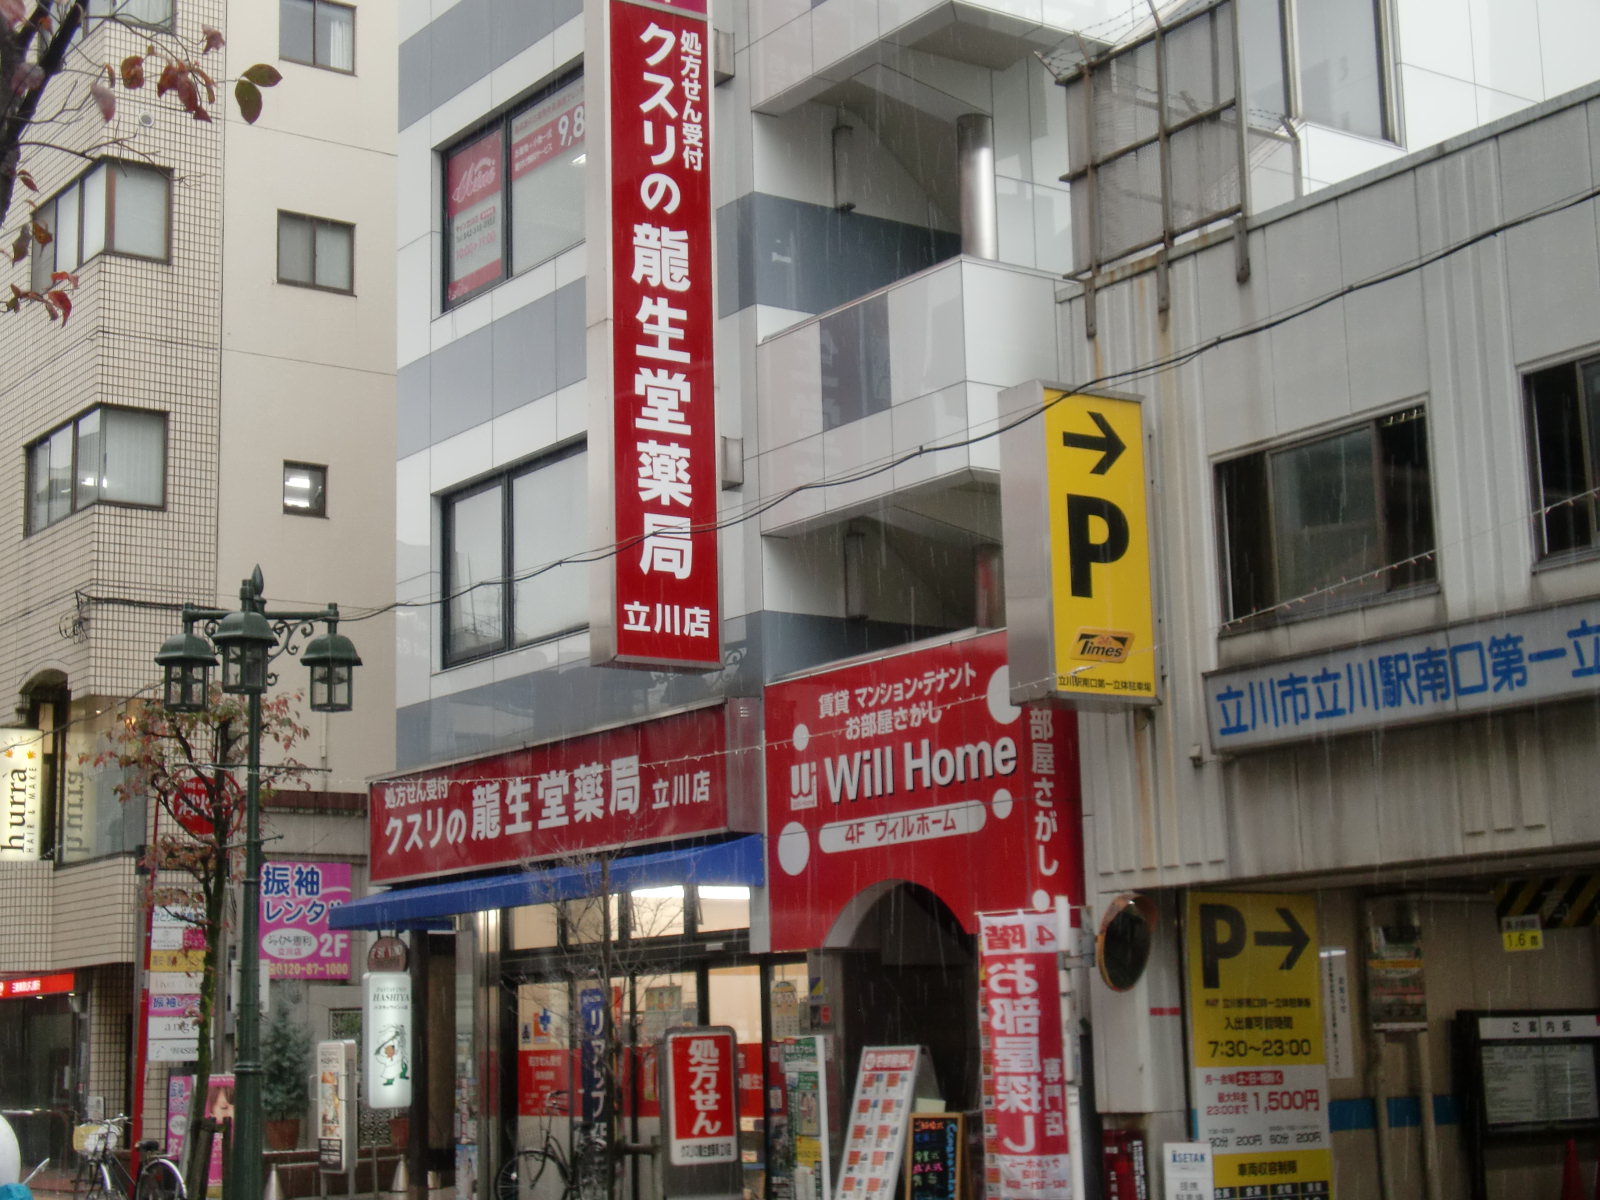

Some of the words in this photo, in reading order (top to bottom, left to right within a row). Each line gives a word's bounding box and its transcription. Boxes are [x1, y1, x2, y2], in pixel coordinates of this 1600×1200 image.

[680, 30, 704, 171] 処方せん受付
[1066, 493, 1130, 599] P
[623, 600, 711, 638] 立川店
[1079, 633, 1127, 658] Times
[818, 689, 850, 719] 賃貸
[854, 662, 977, 710] マンション・テナント
[845, 701, 942, 740] お部屋さがし
[824, 744, 895, 804] Will
[903, 736, 1017, 791] Home
[384, 778, 449, 809] 処方せん受付
[652, 771, 711, 810] 立川店
[845, 824, 865, 845] 4F
[875, 811, 957, 843] ウィルホーム
[263, 864, 321, 897] 振袖
[266, 899, 341, 923] レンタ
[319, 933, 348, 958] 2F
[1199, 903, 1247, 989] P
[688, 1039, 722, 1136] 処方せん
[1252, 1088, 1320, 1114] 1,500円
[1236, 1134, 1263, 1147] 200円
[1296, 1131, 1322, 1144] 200円
